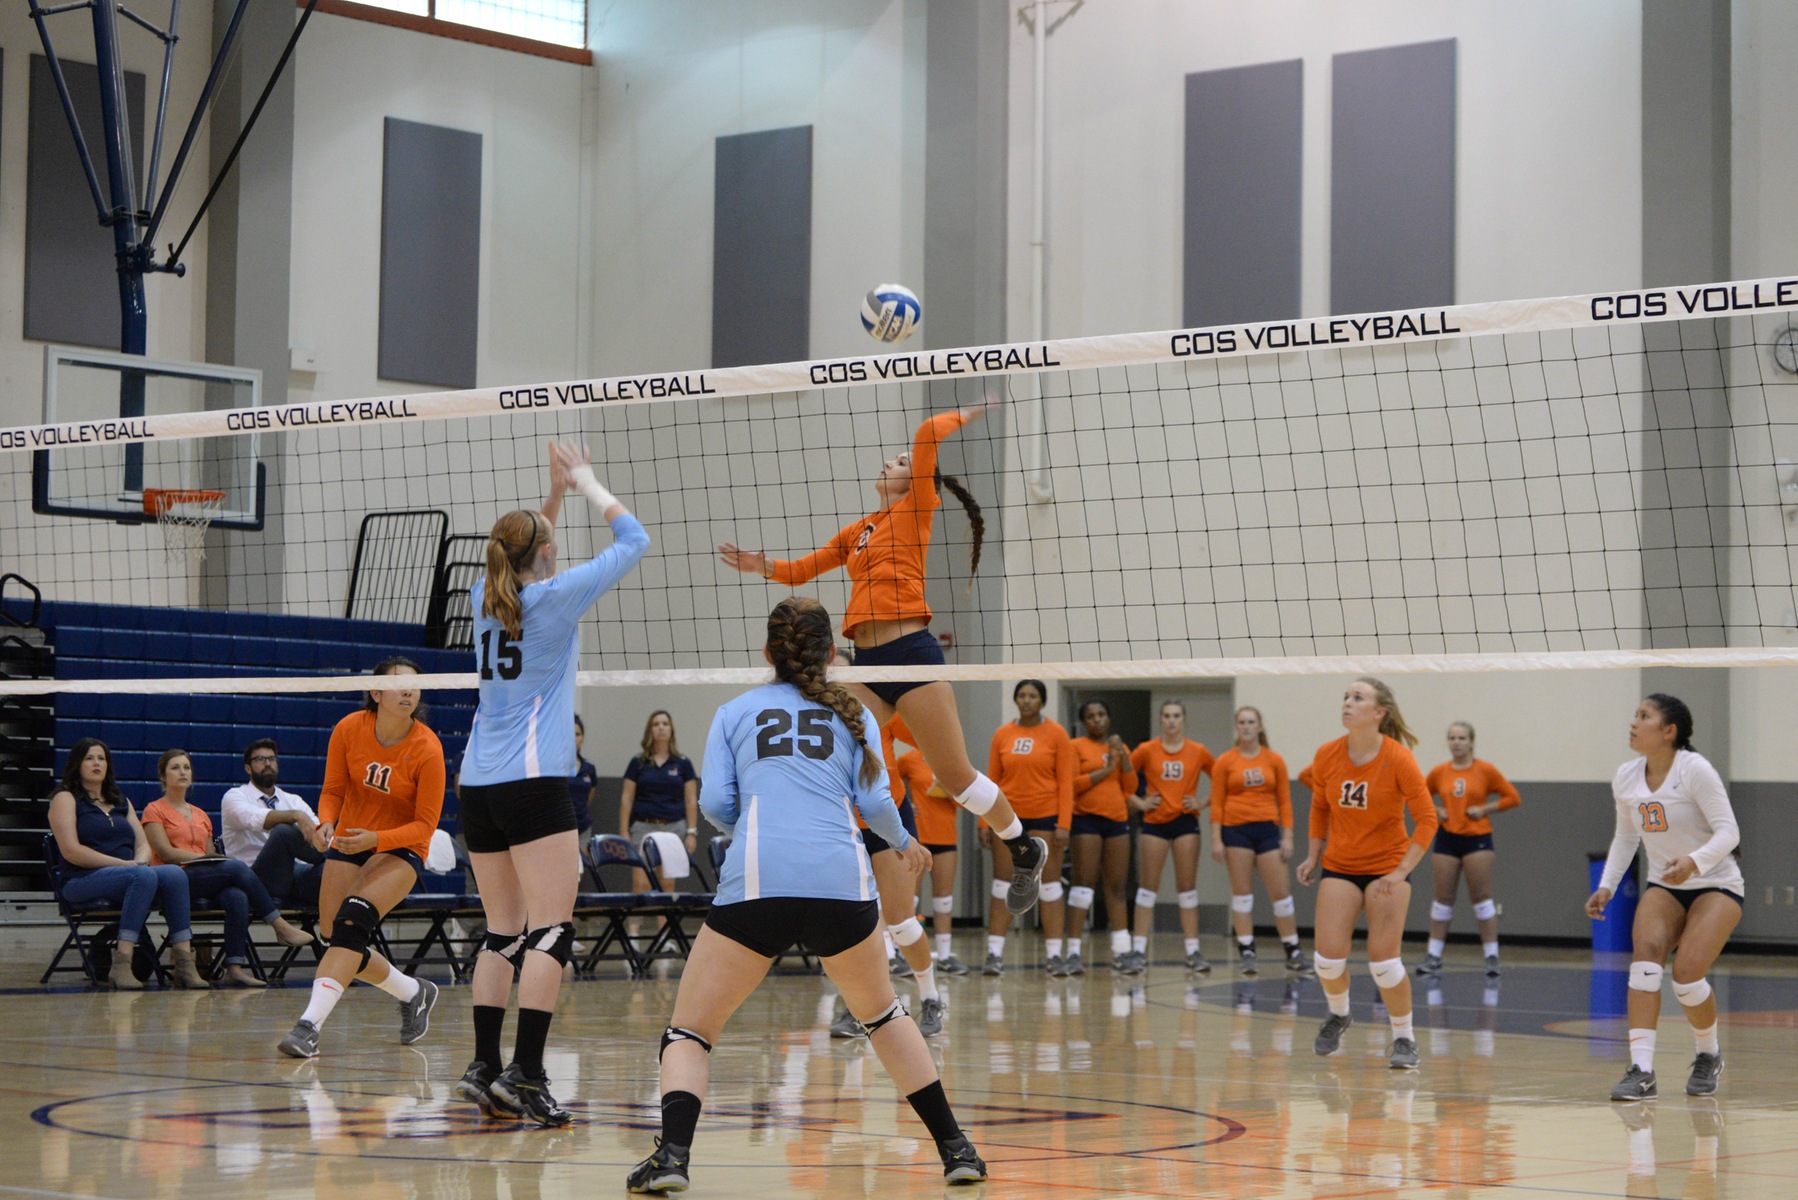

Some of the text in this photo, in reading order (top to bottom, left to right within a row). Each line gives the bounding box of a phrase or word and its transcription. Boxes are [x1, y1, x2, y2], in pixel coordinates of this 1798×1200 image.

[1591, 280, 1798, 321] COS VOLLE
[1171, 311, 1461, 357] COS VOLLEYBALL
[810, 346, 1061, 385] COS VOLLEYBALL
[499, 374, 716, 410] COS VOLLEYBALL
[227, 399, 417, 431] COS VOLLEYBALL
[30, 420, 155, 446] VOLLEYBALL
[481, 629, 524, 680] 15
[756, 709, 834, 761] 25
[1011, 737, 1035, 755] 16
[363, 762, 391, 794] 11
[1162, 761, 1184, 780] 19
[1339, 780, 1368, 810] 14
[1453, 778, 1466, 797] 3
[1639, 801, 1669, 832] 13
